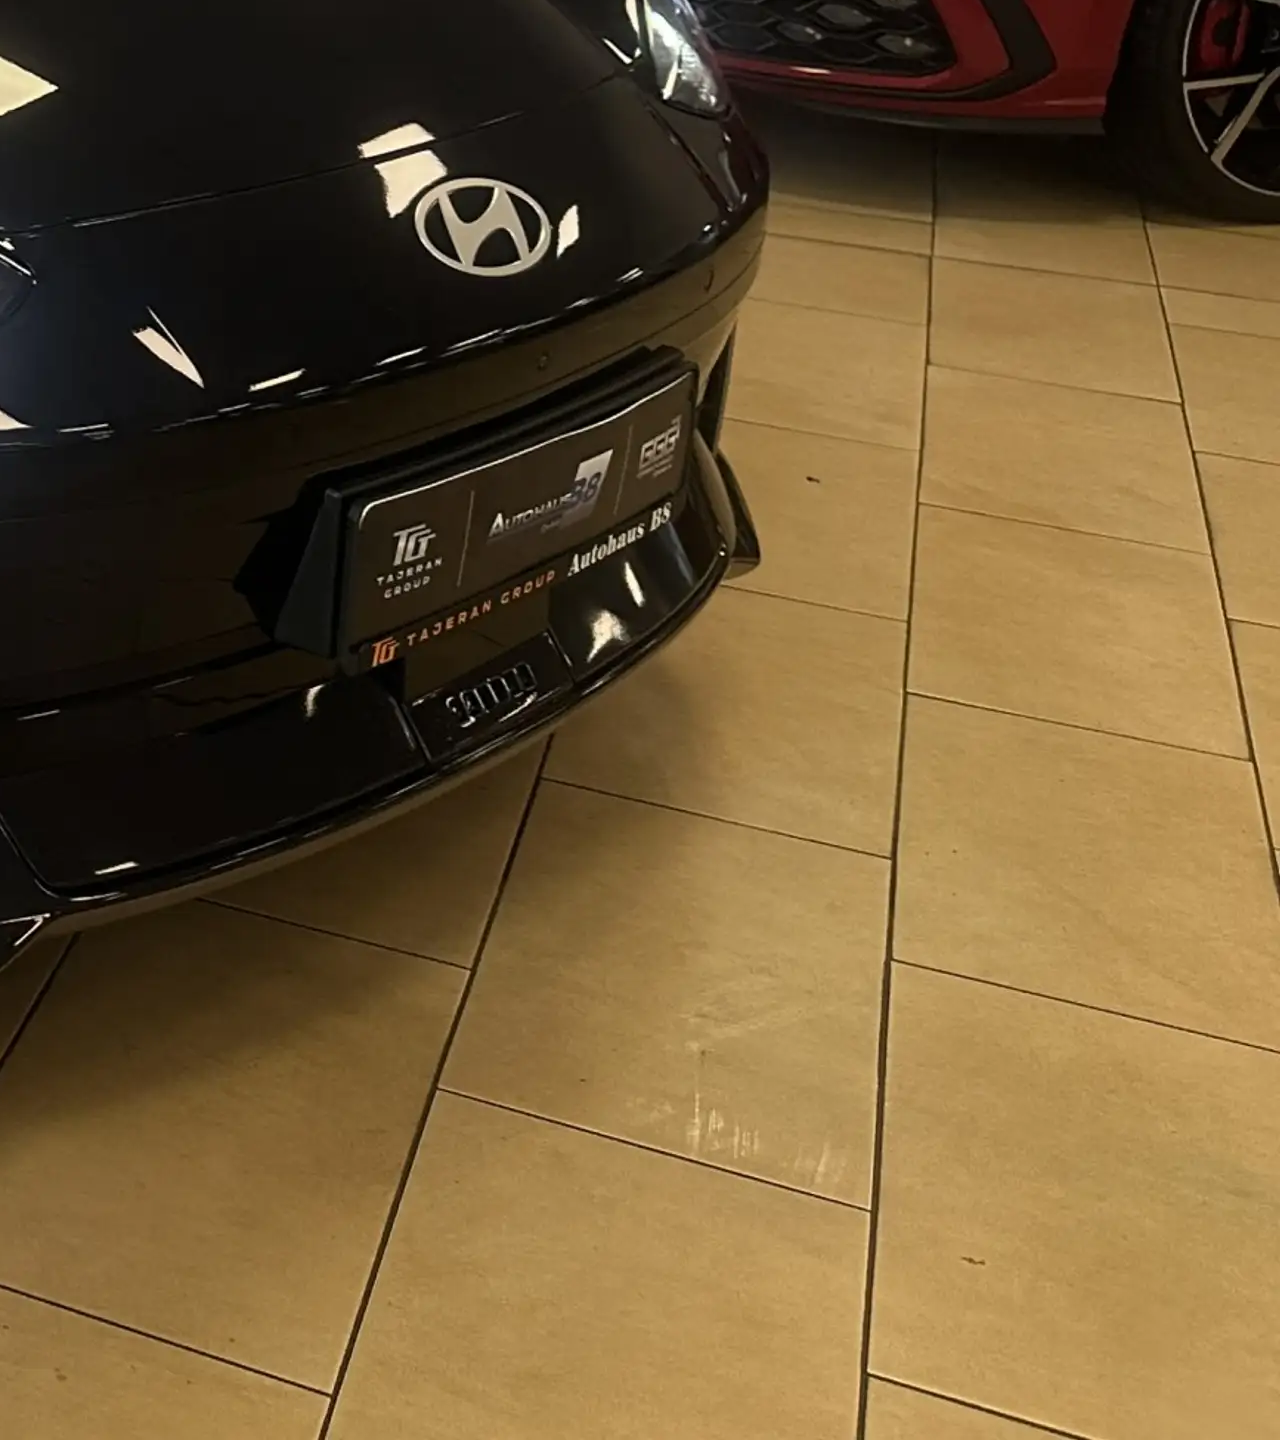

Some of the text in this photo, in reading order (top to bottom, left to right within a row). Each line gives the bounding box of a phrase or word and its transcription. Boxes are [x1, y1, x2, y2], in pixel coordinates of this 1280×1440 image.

[567, 523, 645, 577] Autohaus
[376, 557, 442, 586] TAJERAN
[384, 576, 430, 599] GROUP
[406, 600, 491, 646] TAJERAN
[500, 570, 555, 604] GROUP
